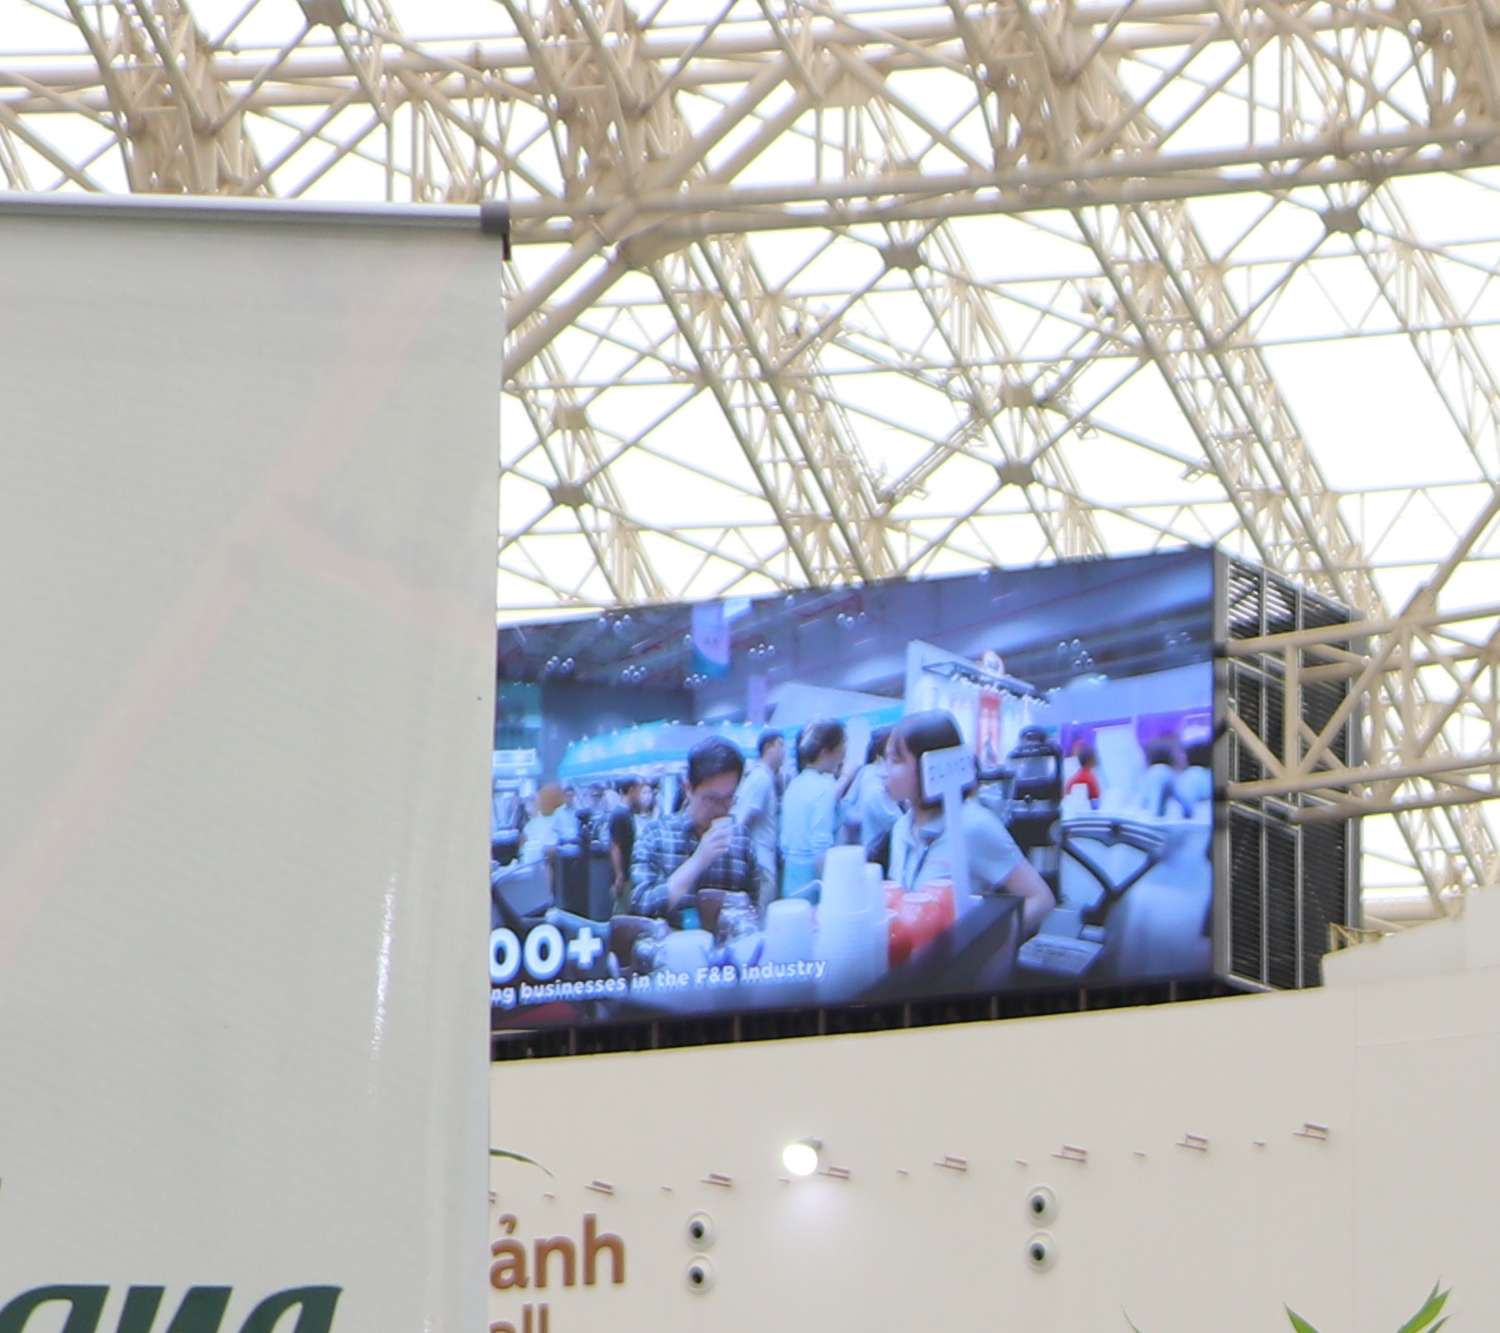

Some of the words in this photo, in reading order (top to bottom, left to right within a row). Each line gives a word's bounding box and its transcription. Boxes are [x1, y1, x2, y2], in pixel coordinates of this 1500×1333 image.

[521, 976, 626, 1002] businesses
[632, 973, 650, 990] in
[656, 969, 688, 988] the
[696, 965, 736, 985] F&B
[741, 959, 827, 983] industry
[489, 1212, 626, 1291] ảnh
